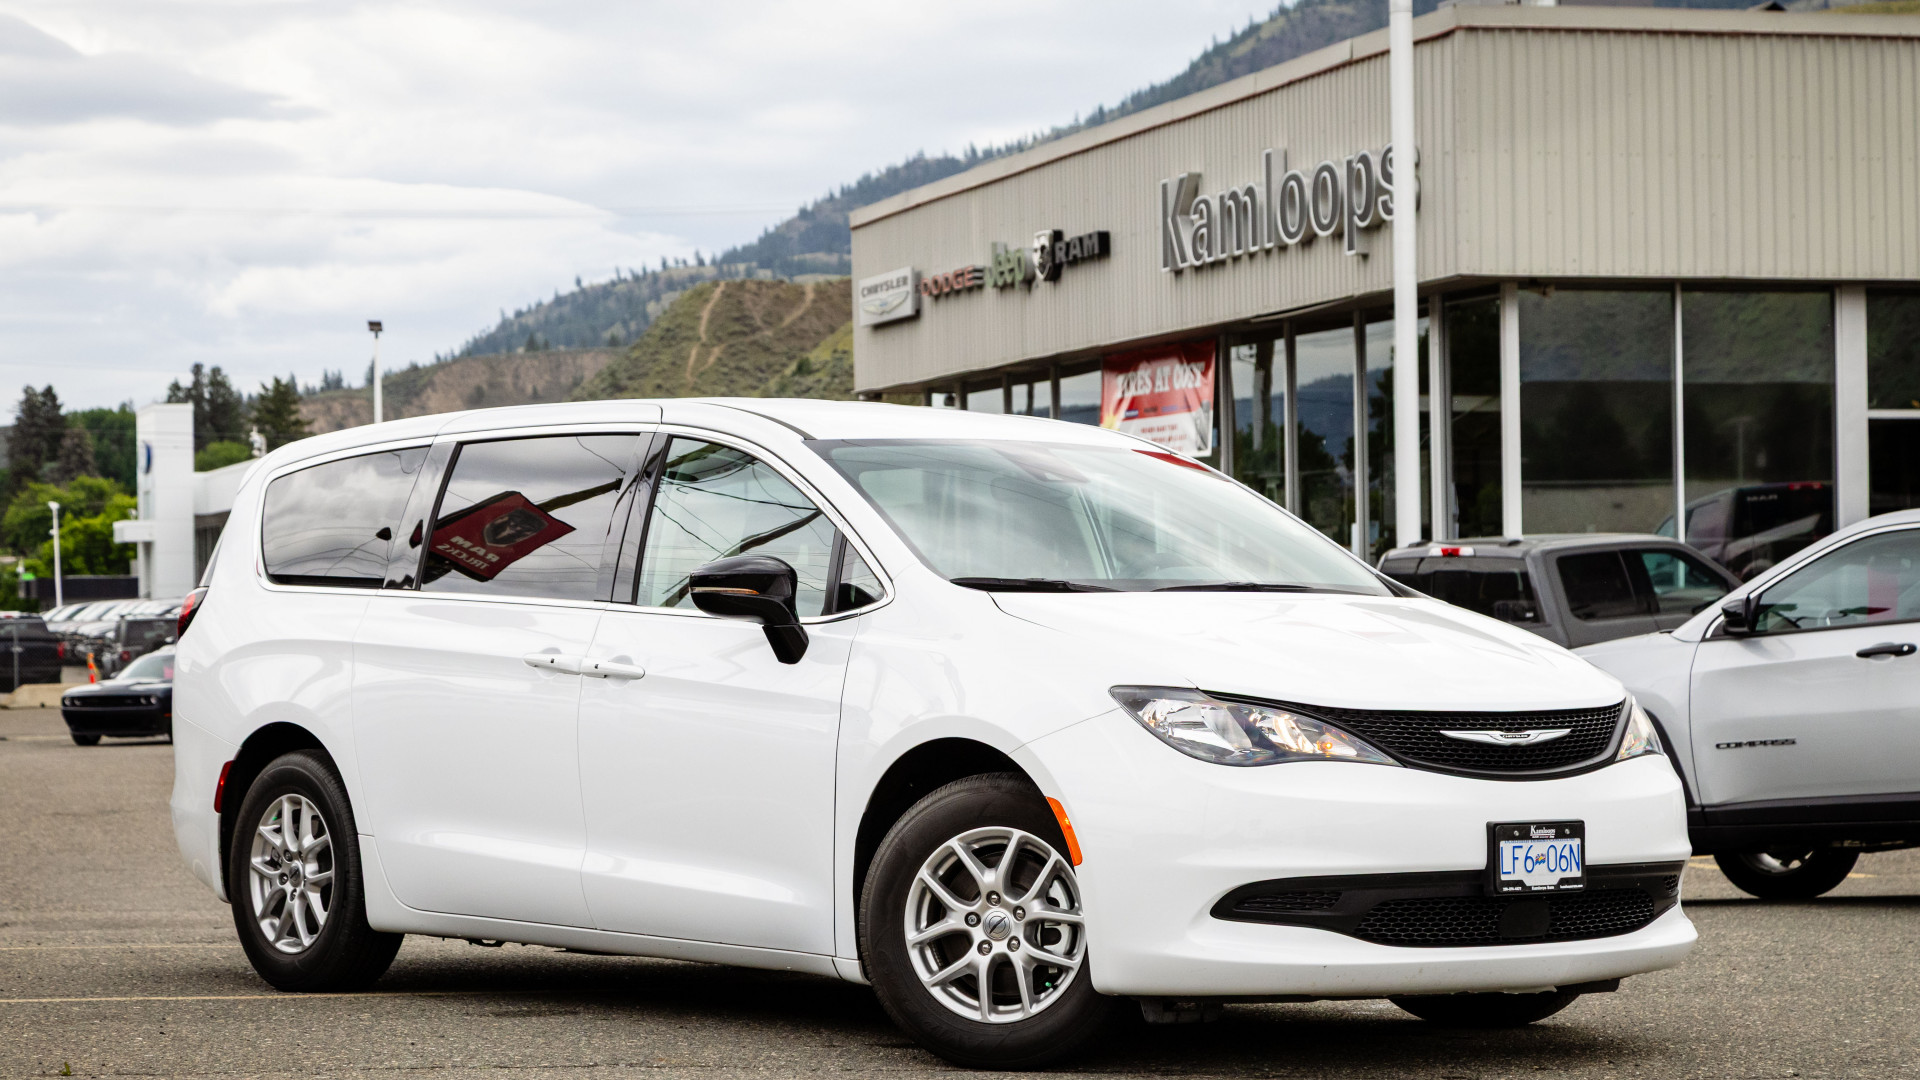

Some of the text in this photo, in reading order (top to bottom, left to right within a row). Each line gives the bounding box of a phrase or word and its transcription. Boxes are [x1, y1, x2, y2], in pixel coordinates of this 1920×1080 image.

[1160, 143, 1396, 272] Kamloops
[1055, 232, 1099, 264] RAM
[921, 265, 976, 297] DODGE
[984, 242, 1025, 290] Jeep
[861, 276, 909, 298] CHRYSLER
[1154, 365, 1172, 393] AT
[1715, 738, 1797, 749] COMPASS
[1500, 843, 1580, 875] LF6 06N
